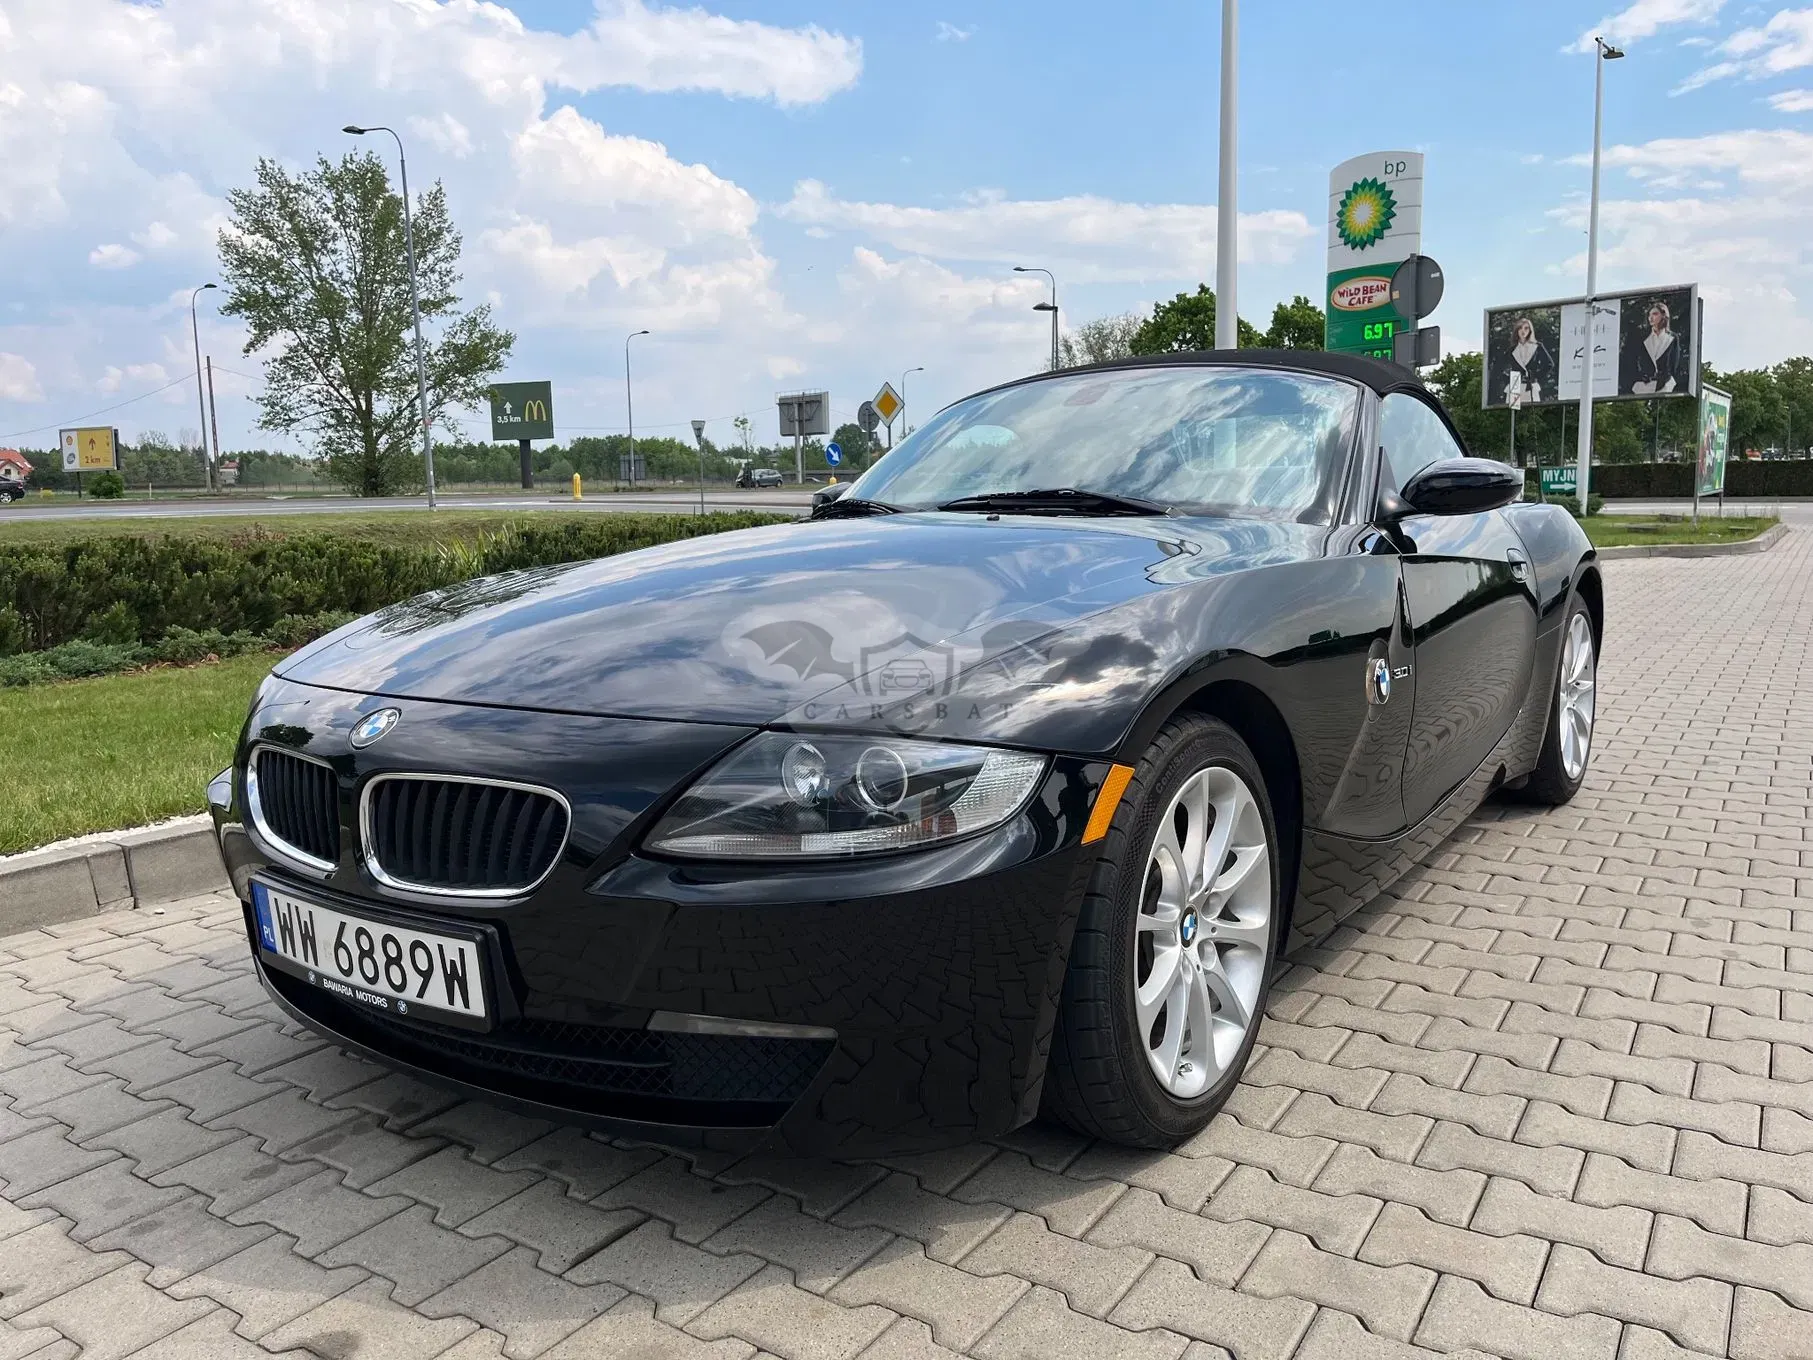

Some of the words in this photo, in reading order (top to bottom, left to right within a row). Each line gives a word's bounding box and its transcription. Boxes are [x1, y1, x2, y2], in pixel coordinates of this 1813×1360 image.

[1384, 160, 1407, 178] bp
[1362, 283, 1387, 296] BEAN
[1348, 295, 1374, 306] CAFE
[496, 415, 509, 424] 3,5
[509, 415, 521, 423] km
[90, 455, 101, 464] km
[263, 925, 274, 943] PL
[274, 897, 319, 967] WW
[333, 920, 470, 1010] 6889W
[323, 978, 353, 998] BAWARIA
[355, 989, 388, 1009] MOTORS
